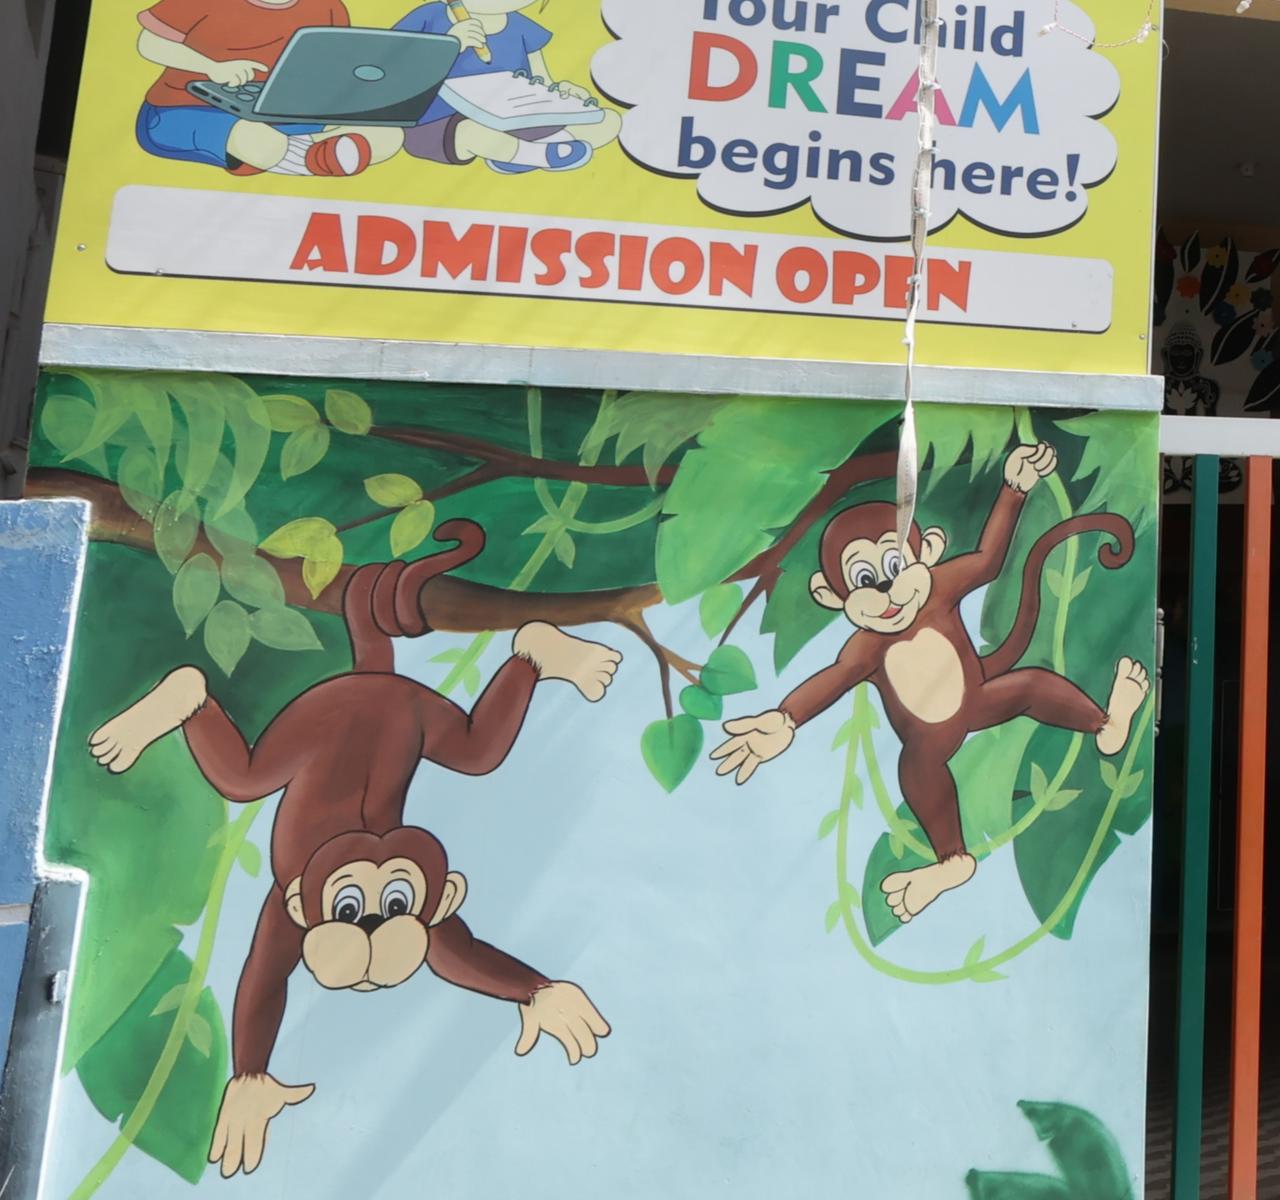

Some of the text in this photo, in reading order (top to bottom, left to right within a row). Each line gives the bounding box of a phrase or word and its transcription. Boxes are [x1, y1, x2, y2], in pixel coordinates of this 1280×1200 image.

[687, 31, 1040, 135] DREAM
[677, 116, 1080, 202] begins here!
[289, 212, 972, 313] ADMISSION OPEN
